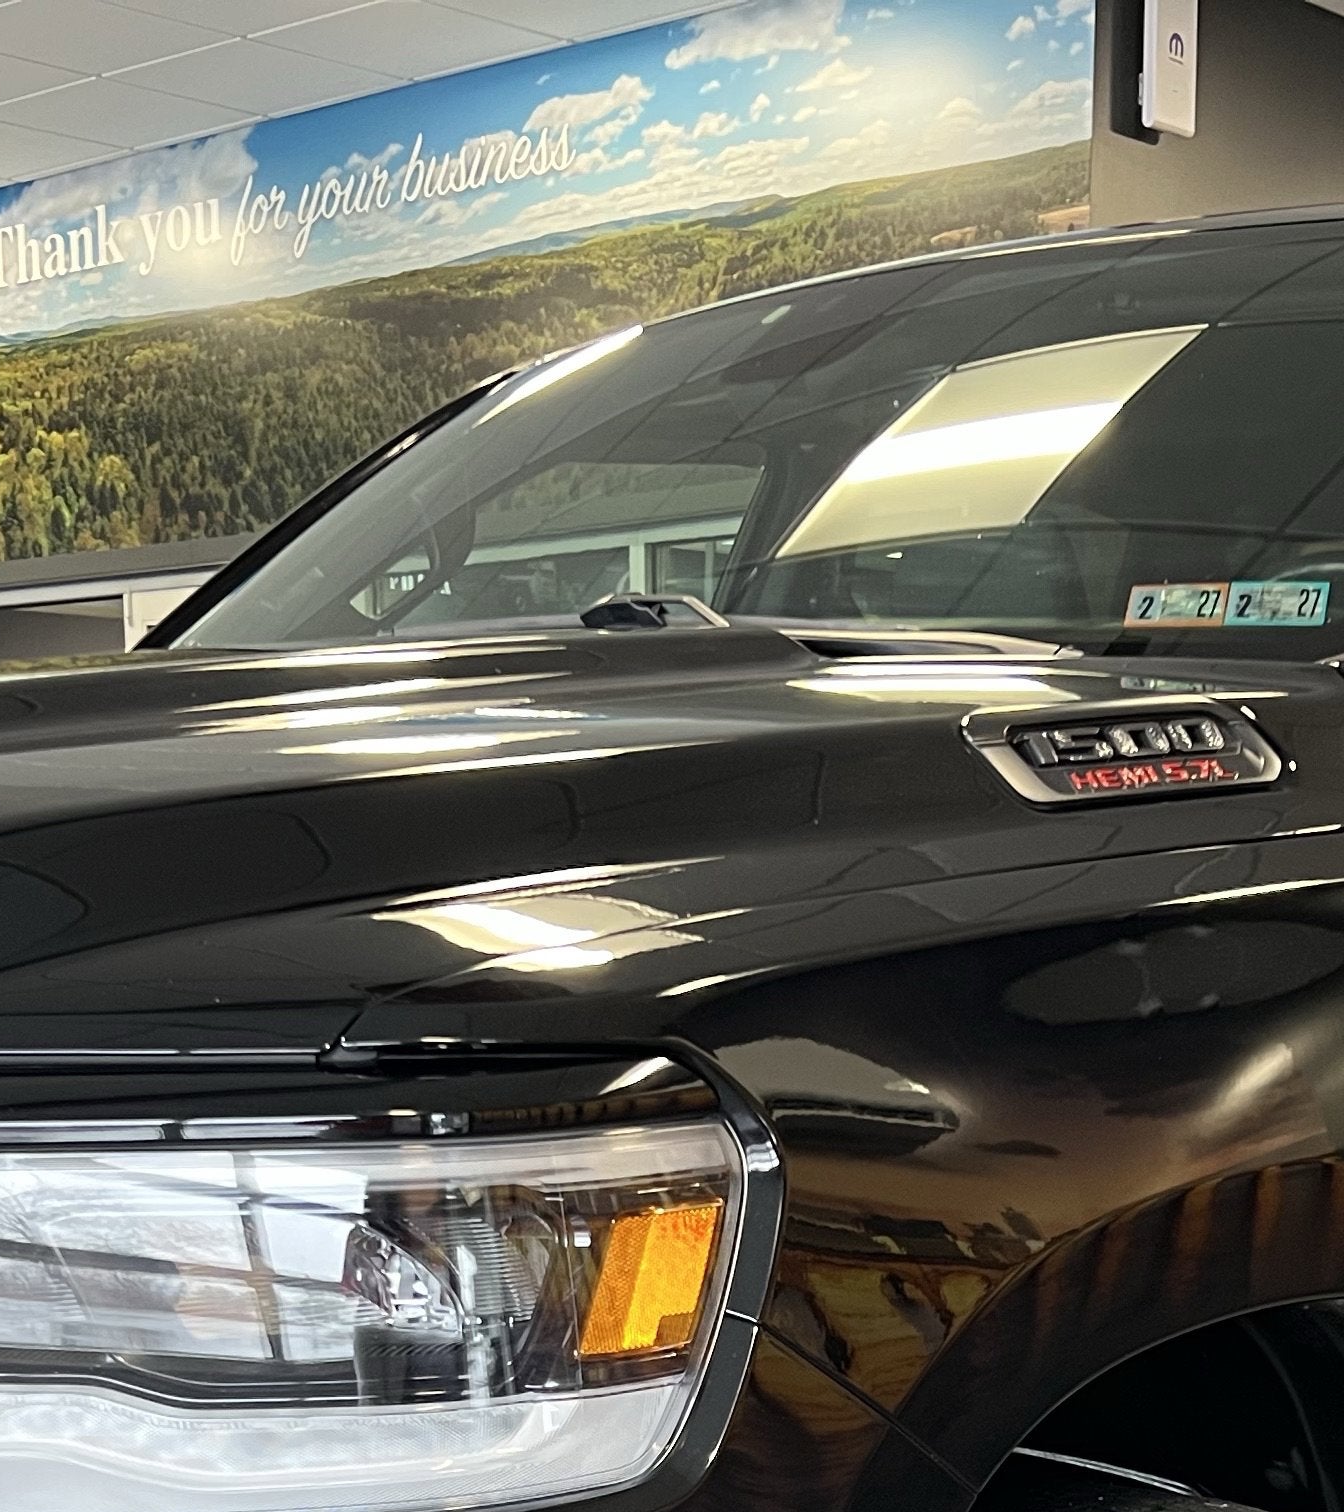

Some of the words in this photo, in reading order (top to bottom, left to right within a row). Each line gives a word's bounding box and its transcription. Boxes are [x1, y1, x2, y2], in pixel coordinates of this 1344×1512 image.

[138, 198, 221, 276] you
[230, 175, 290, 266] for
[293, 166, 392, 258] your
[400, 123, 576, 203] business
[1197, 590, 1221, 618] 27
[1237, 594, 1252, 618] 2
[1297, 589, 1321, 618] 27
[1014, 719, 1225, 766] 1500
[1068, 766, 1159, 793] HEMI
[1162, 758, 1240, 783] 5.7L
